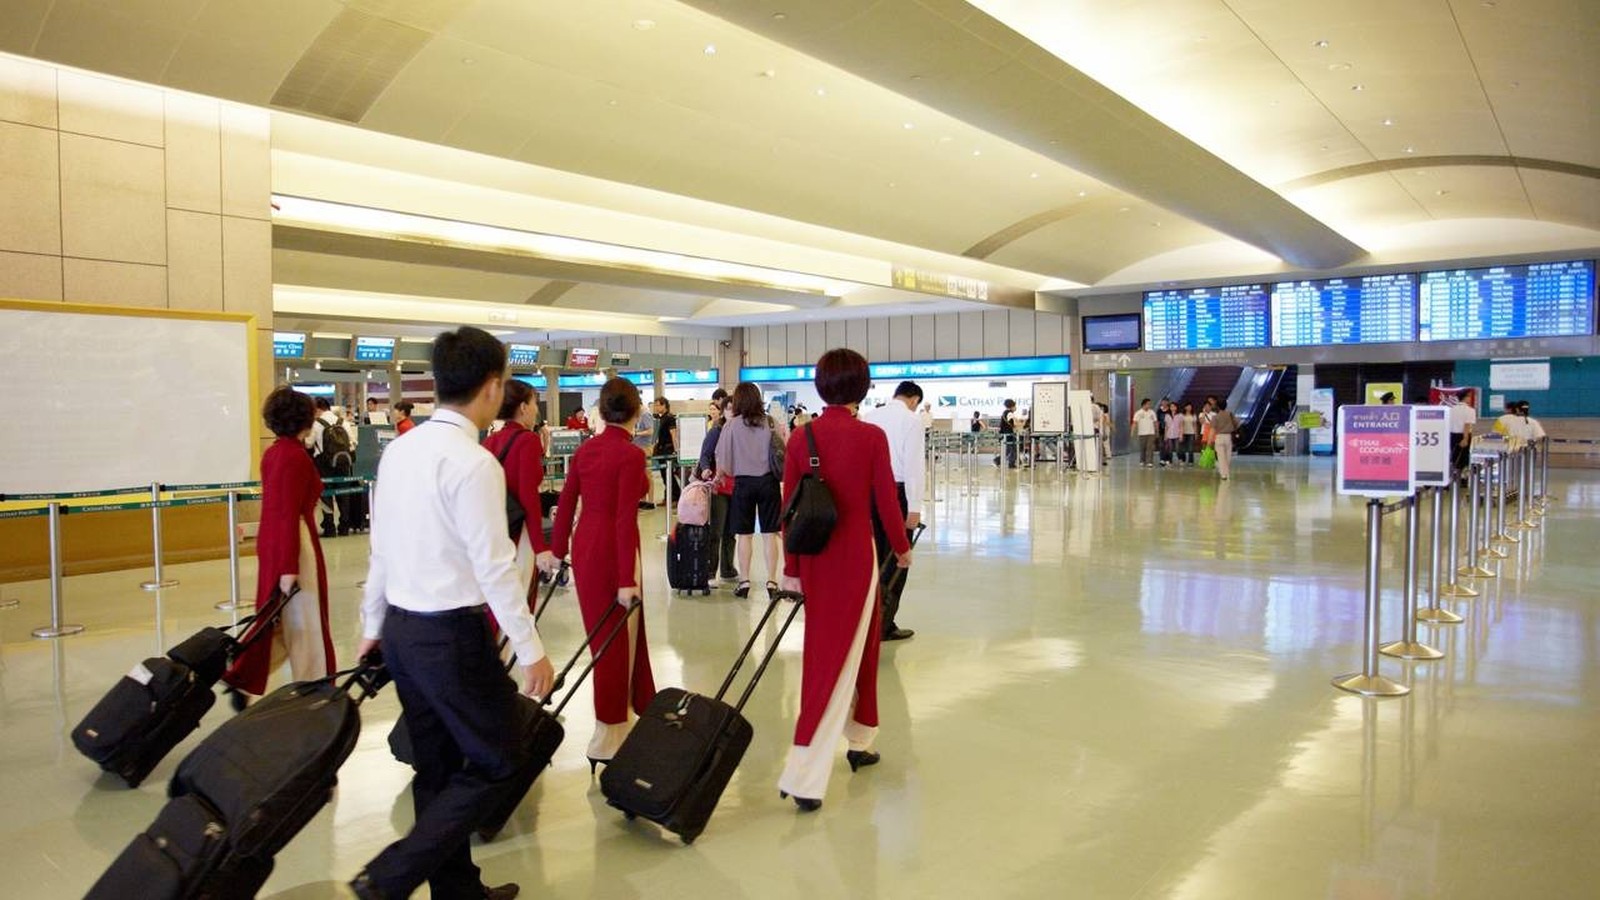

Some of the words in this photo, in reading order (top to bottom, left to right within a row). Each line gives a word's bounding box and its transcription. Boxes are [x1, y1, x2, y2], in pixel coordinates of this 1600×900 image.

[959, 396, 995, 406] CATHAY
[997, 396, 1031, 406] PIFIC
[1359, 446, 1402, 454] ECONOMY
